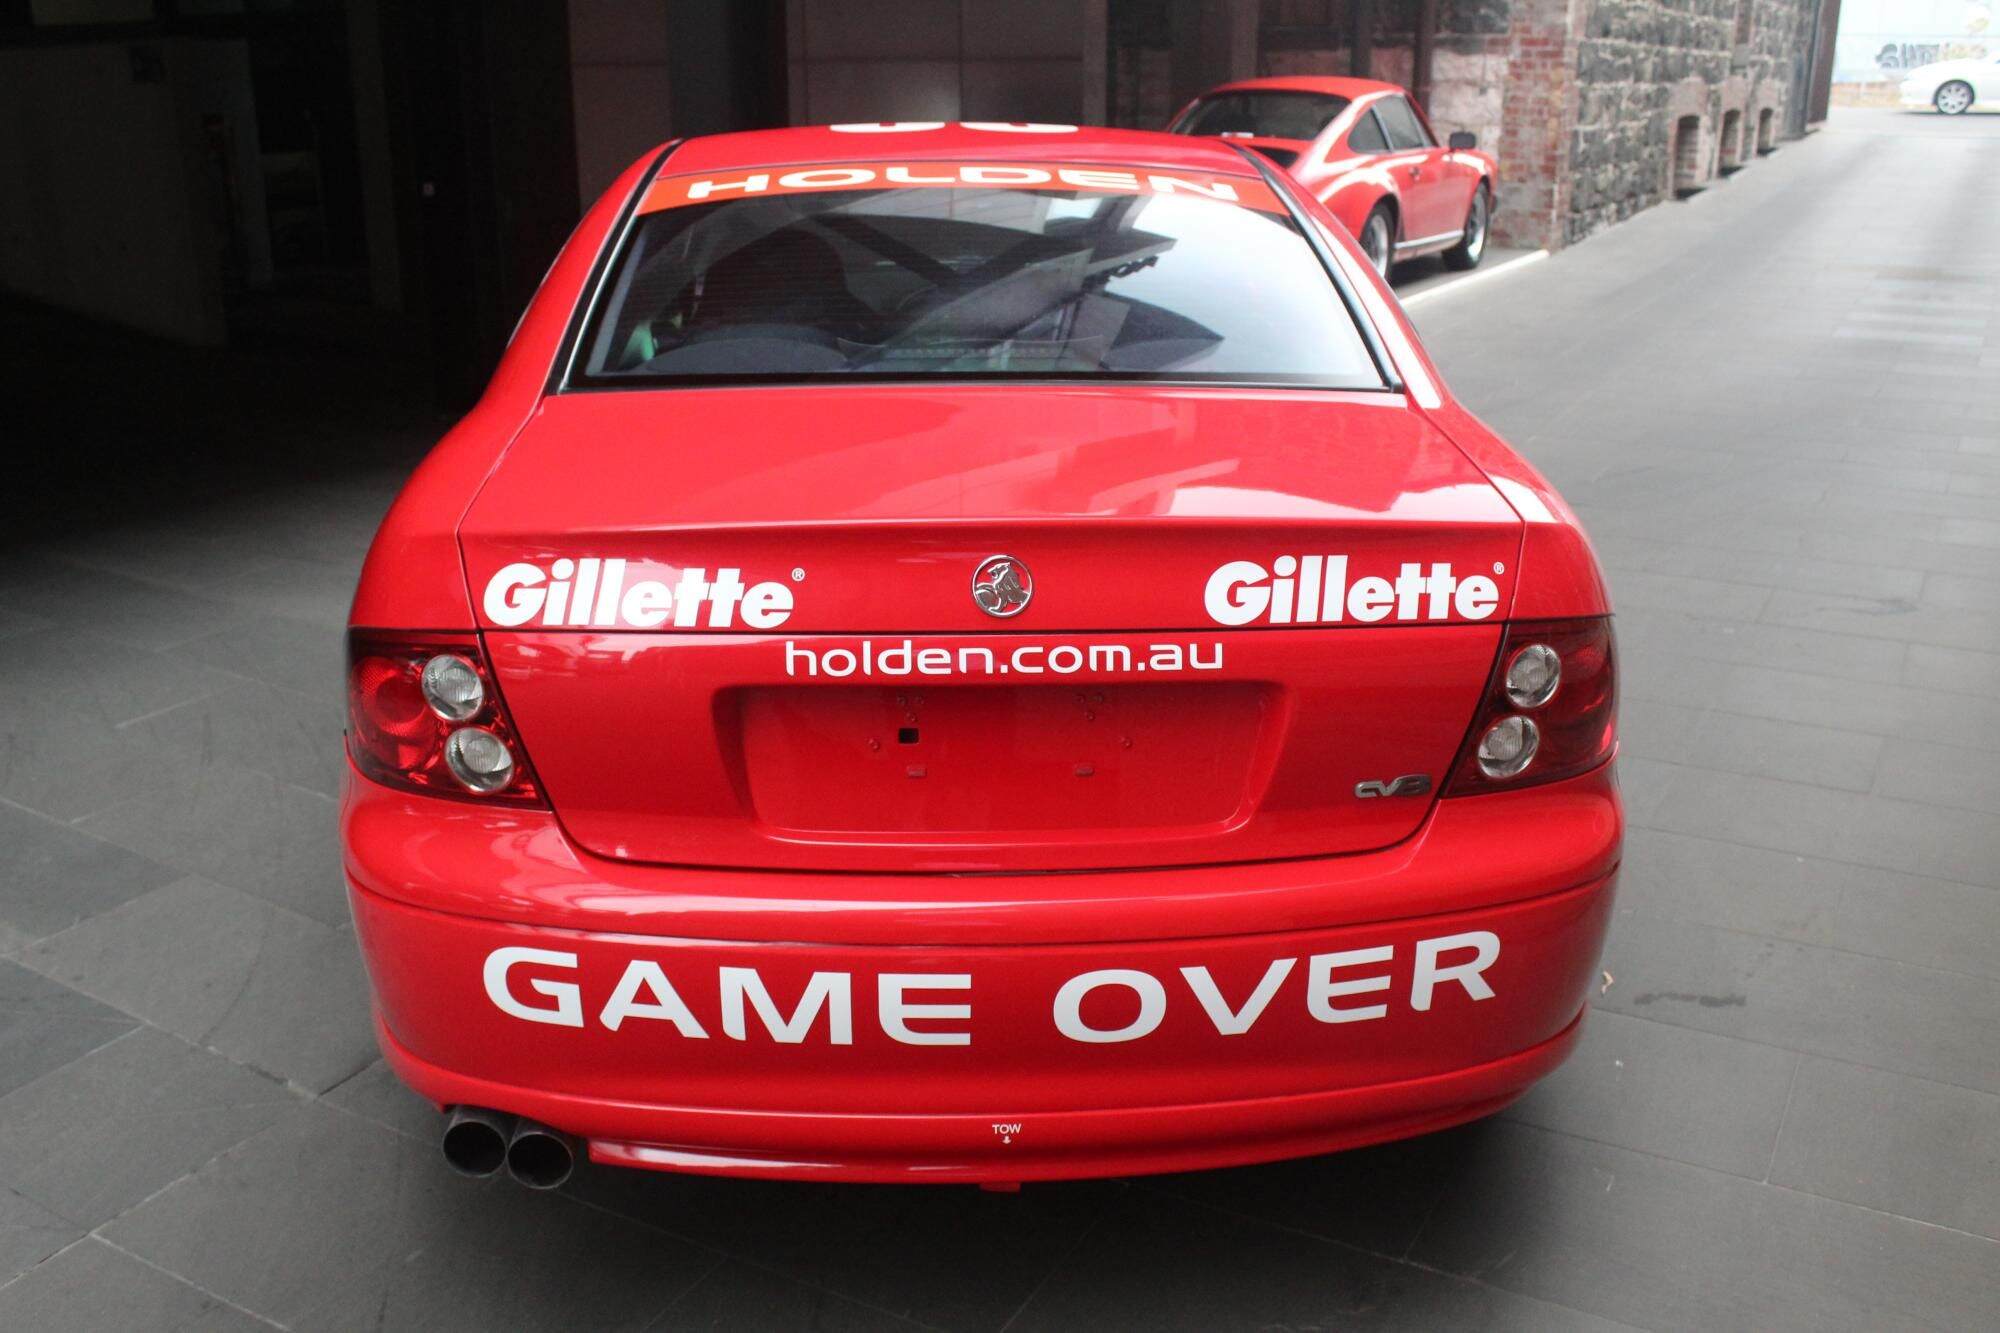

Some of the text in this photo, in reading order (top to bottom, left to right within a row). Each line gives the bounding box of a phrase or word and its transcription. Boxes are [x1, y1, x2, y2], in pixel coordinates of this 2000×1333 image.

[687, 166, 1239, 201] HOLDEN
[785, 639, 1224, 678] holden.com.au
[483, 930, 1502, 1046] GAME OVER
[991, 1123, 1022, 1135] TOW
